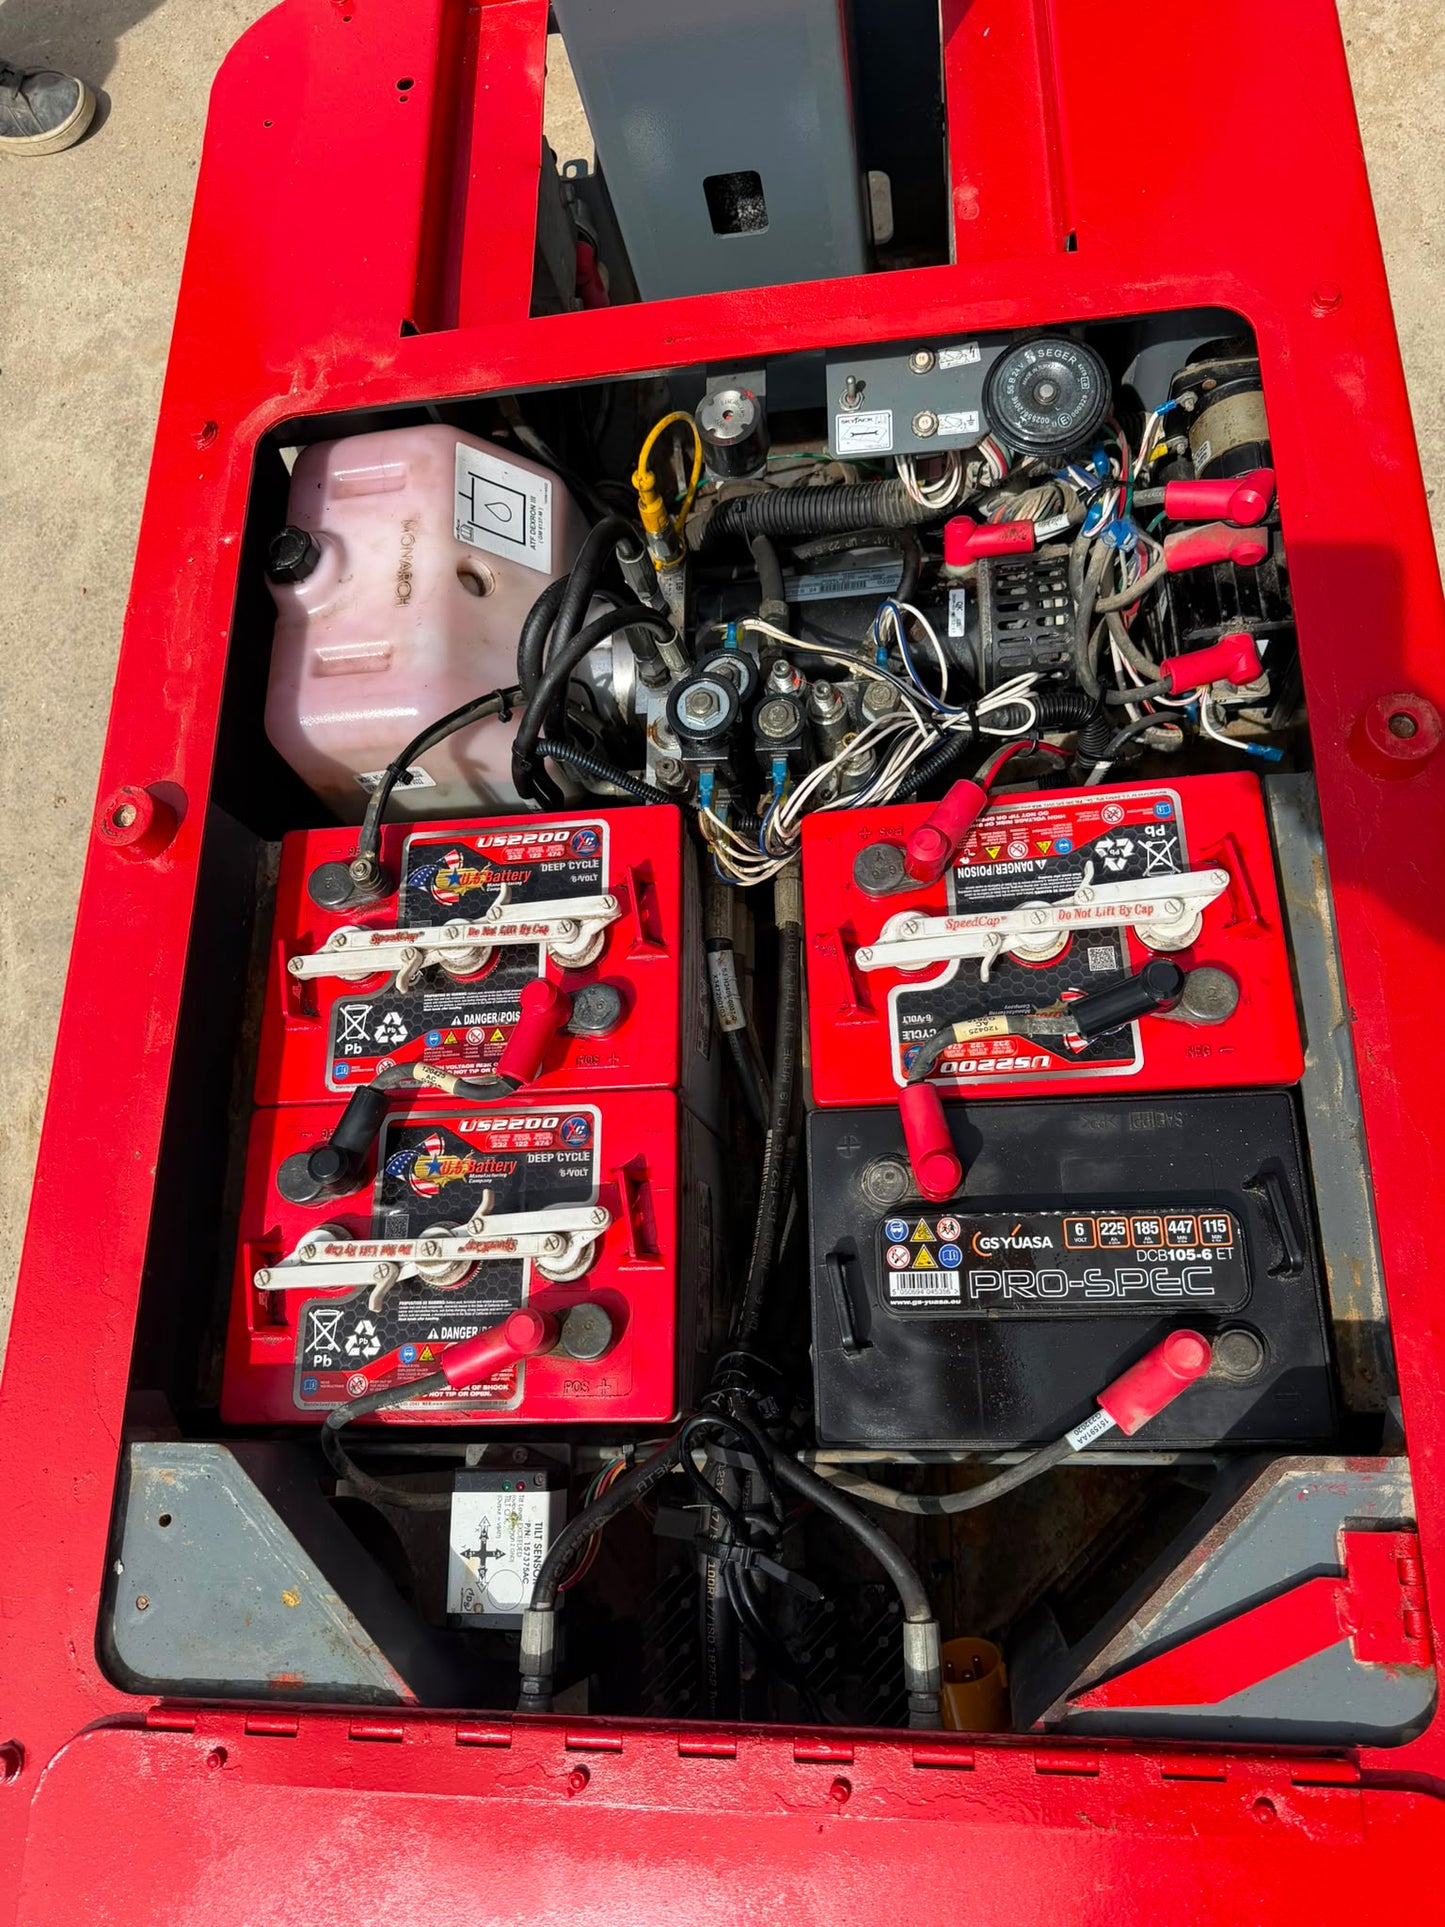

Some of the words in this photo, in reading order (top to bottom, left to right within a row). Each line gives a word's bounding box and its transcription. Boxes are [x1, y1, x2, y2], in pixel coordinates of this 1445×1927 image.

[1038, 349, 1077, 364] SEGER
[394, 519, 416, 608] MONARCH
[1014, 816, 1046, 824] VOLTAGE
[879, 825, 904, 836] POS
[1144, 825, 1166, 836] Pb
[477, 831, 570, 848] US2200
[541, 862, 566, 872] DEEP
[568, 860, 600, 870] CYCLE
[958, 861, 1034, 878] DANGER/POISON
[485, 870, 531, 884] Battery
[571, 874, 598, 882] 6-VOLT
[1058, 910, 1071, 920] Do
[1074, 908, 1092, 920] Not
[1096, 906, 1116, 918] Lift
[1118, 906, 1132, 918] By
[1134, 904, 1154, 916] Cap
[466, 927, 480, 938] Do
[482, 926, 497, 937] Not
[519, 924, 530, 936] By
[533, 924, 550, 936] Cap
[785, 970, 797, 1011] ITALY
[464, 1011, 521, 1026] DANGER/POIS
[902, 1014, 934, 1024] 6-VOLT
[784, 1022, 794, 1034] IN
[902, 1028, 937, 1040] CYCLE
[968, 1024, 998, 1035] 120425
[344, 1043, 362, 1054] Pb
[1186, 1044, 1212, 1058] NEG
[782, 1049, 792, 1083] MADE
[940, 1055, 1050, 1074] US2200
[422, 1066, 446, 1078] 120425
[459, 1117, 559, 1133] US2200
[491, 1140, 508, 1148] 232
[528, 1152, 554, 1164] DEEP
[557, 1152, 590, 1162] CYCLE
[441, 1160, 464, 1176] U.S.
[467, 1159, 517, 1175] Battery
[560, 1168, 589, 1177] 6-VOLT
[1074, 1222, 1084, 1236] 6
[1100, 1222, 1126, 1236] 225
[1134, 1221, 1159, 1234] 185
[1168, 1220, 1193, 1234] 447
[1202, 1220, 1226, 1233] 115
[324, 1246, 343, 1257] Cap
[1136, 1249, 1212, 1262] DCB105-6
[1216, 1247, 1234, 1260] ET
[968, 1266, 1215, 1299] PRO-SPEC
[313, 1355, 332, 1368] Pb
[563, 1380, 590, 1394] POS
[1073, 1412, 1102, 1436] G232020
[1076, 1418, 1110, 1444] 151591AA
[524, 1522, 532, 1539] P/N:
[534, 1522, 543, 1540] TILT
[523, 1542, 531, 1584] 157375AC
